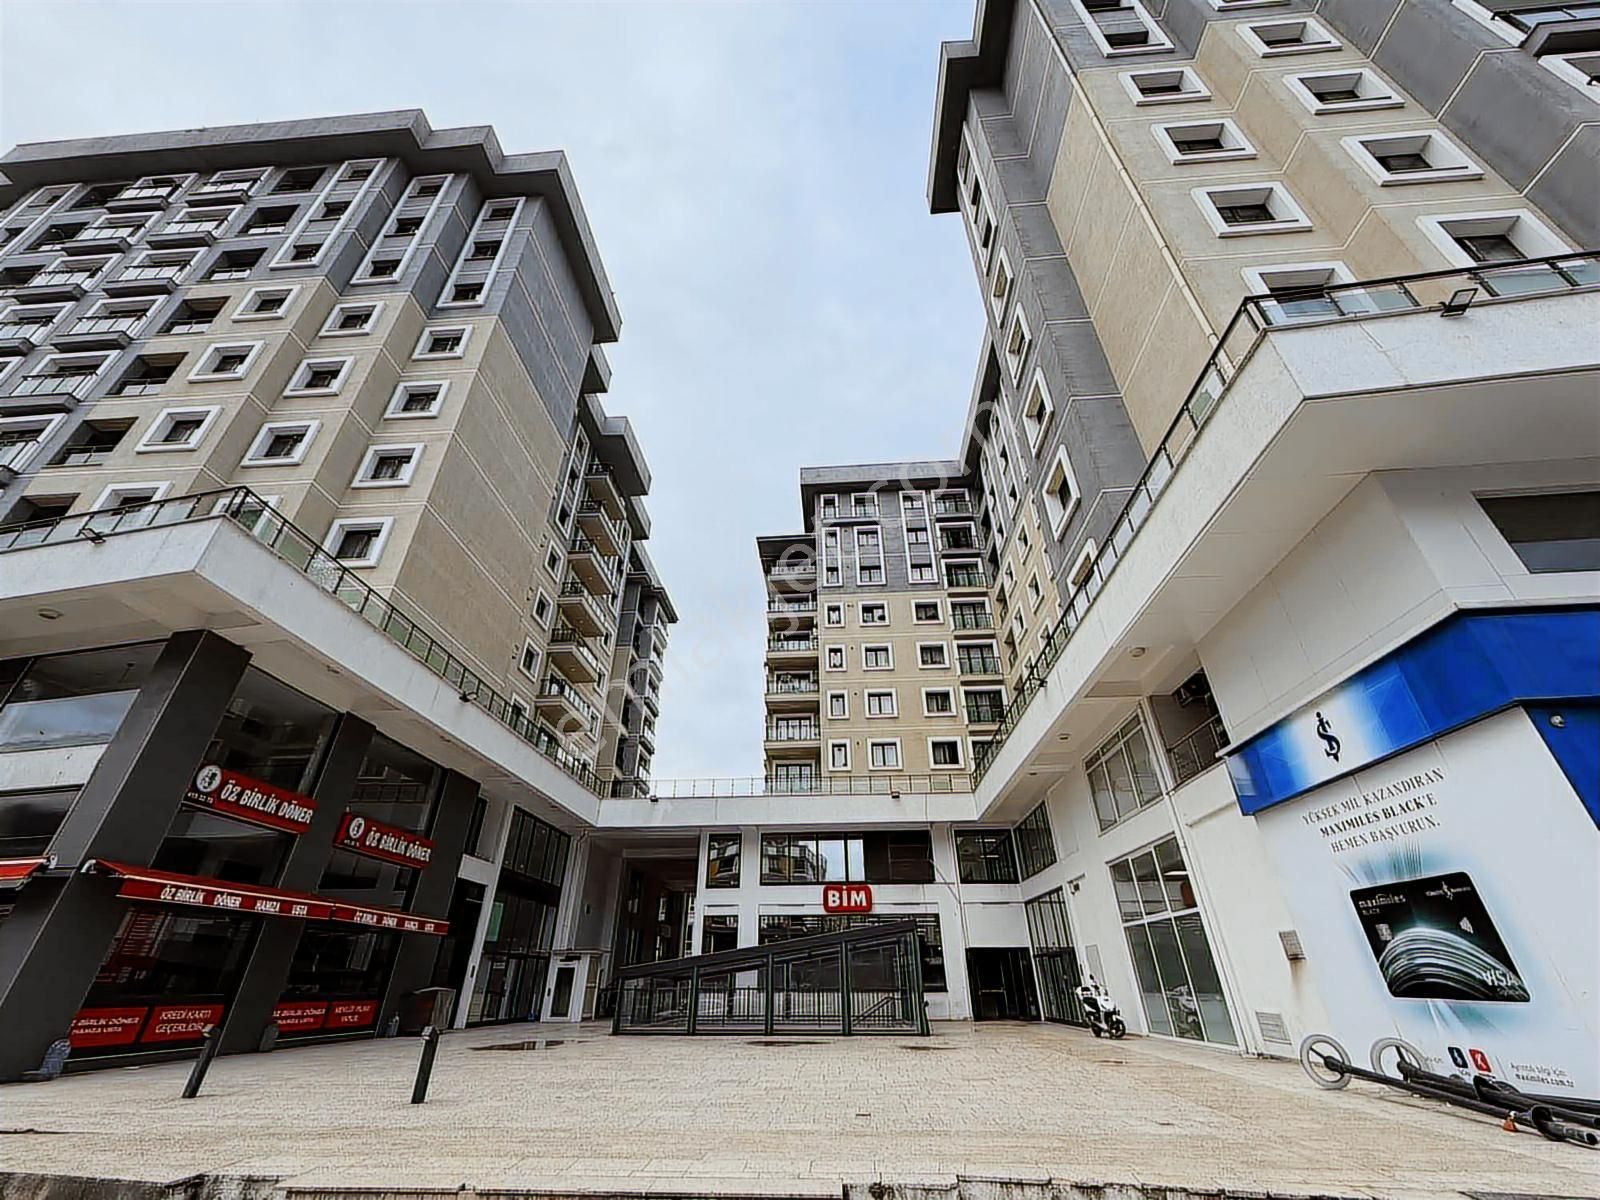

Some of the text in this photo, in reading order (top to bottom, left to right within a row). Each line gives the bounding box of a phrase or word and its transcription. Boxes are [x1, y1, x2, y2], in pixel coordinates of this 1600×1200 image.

[221, 779, 242, 801] ÖZ
[240, 788, 280, 814] BİRLİK
[278, 800, 313, 824] DÖNER
[1303, 767, 1445, 825] YÜKSEK MİL KAZANDIRAN
[1320, 792, 1437, 838] MAXIMILES BLACK'E
[1331, 814, 1441, 853] HEMEN BAŞVURUN.
[366, 827, 381, 847] ÖZ
[379, 833, 407, 855] BİRLİK
[406, 841, 432, 862] DÖNER
[160, 884, 177, 900] ÖZ
[174, 888, 206, 904] BİRLİK
[213, 893, 242, 908] DÖNER
[827, 885, 868, 907] BİM
[159, 1010, 187, 1021] KREDİ
